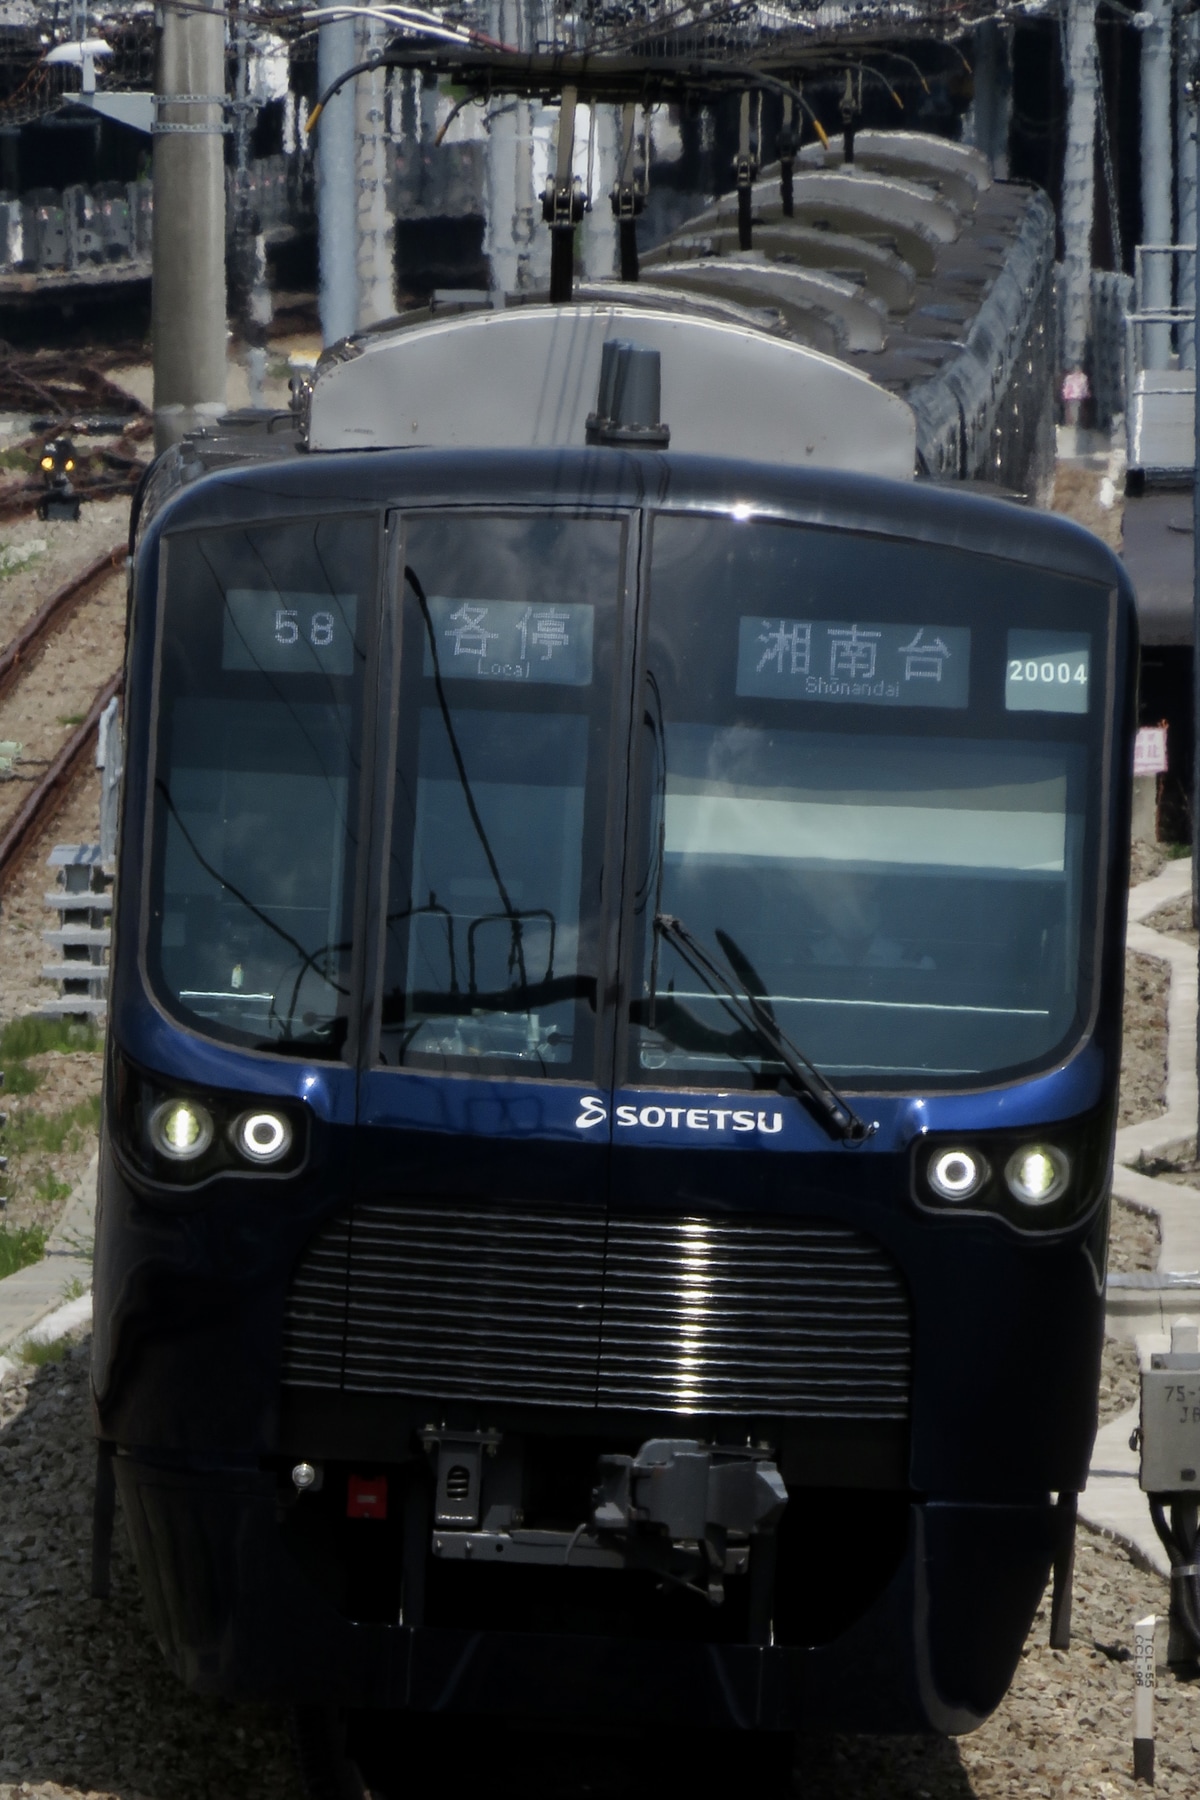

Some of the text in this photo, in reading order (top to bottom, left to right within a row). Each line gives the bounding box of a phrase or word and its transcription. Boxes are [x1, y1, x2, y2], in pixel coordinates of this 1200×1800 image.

[275, 609, 335, 646] 58
[444, 602, 571, 661] 各停
[756, 620, 951, 682] 湘南台
[478, 658, 530, 679] Local
[1009, 660, 1088, 685] 20004
[615, 1105, 783, 1134] SOTETSU
[1164, 1385, 1200, 1403] 75-
